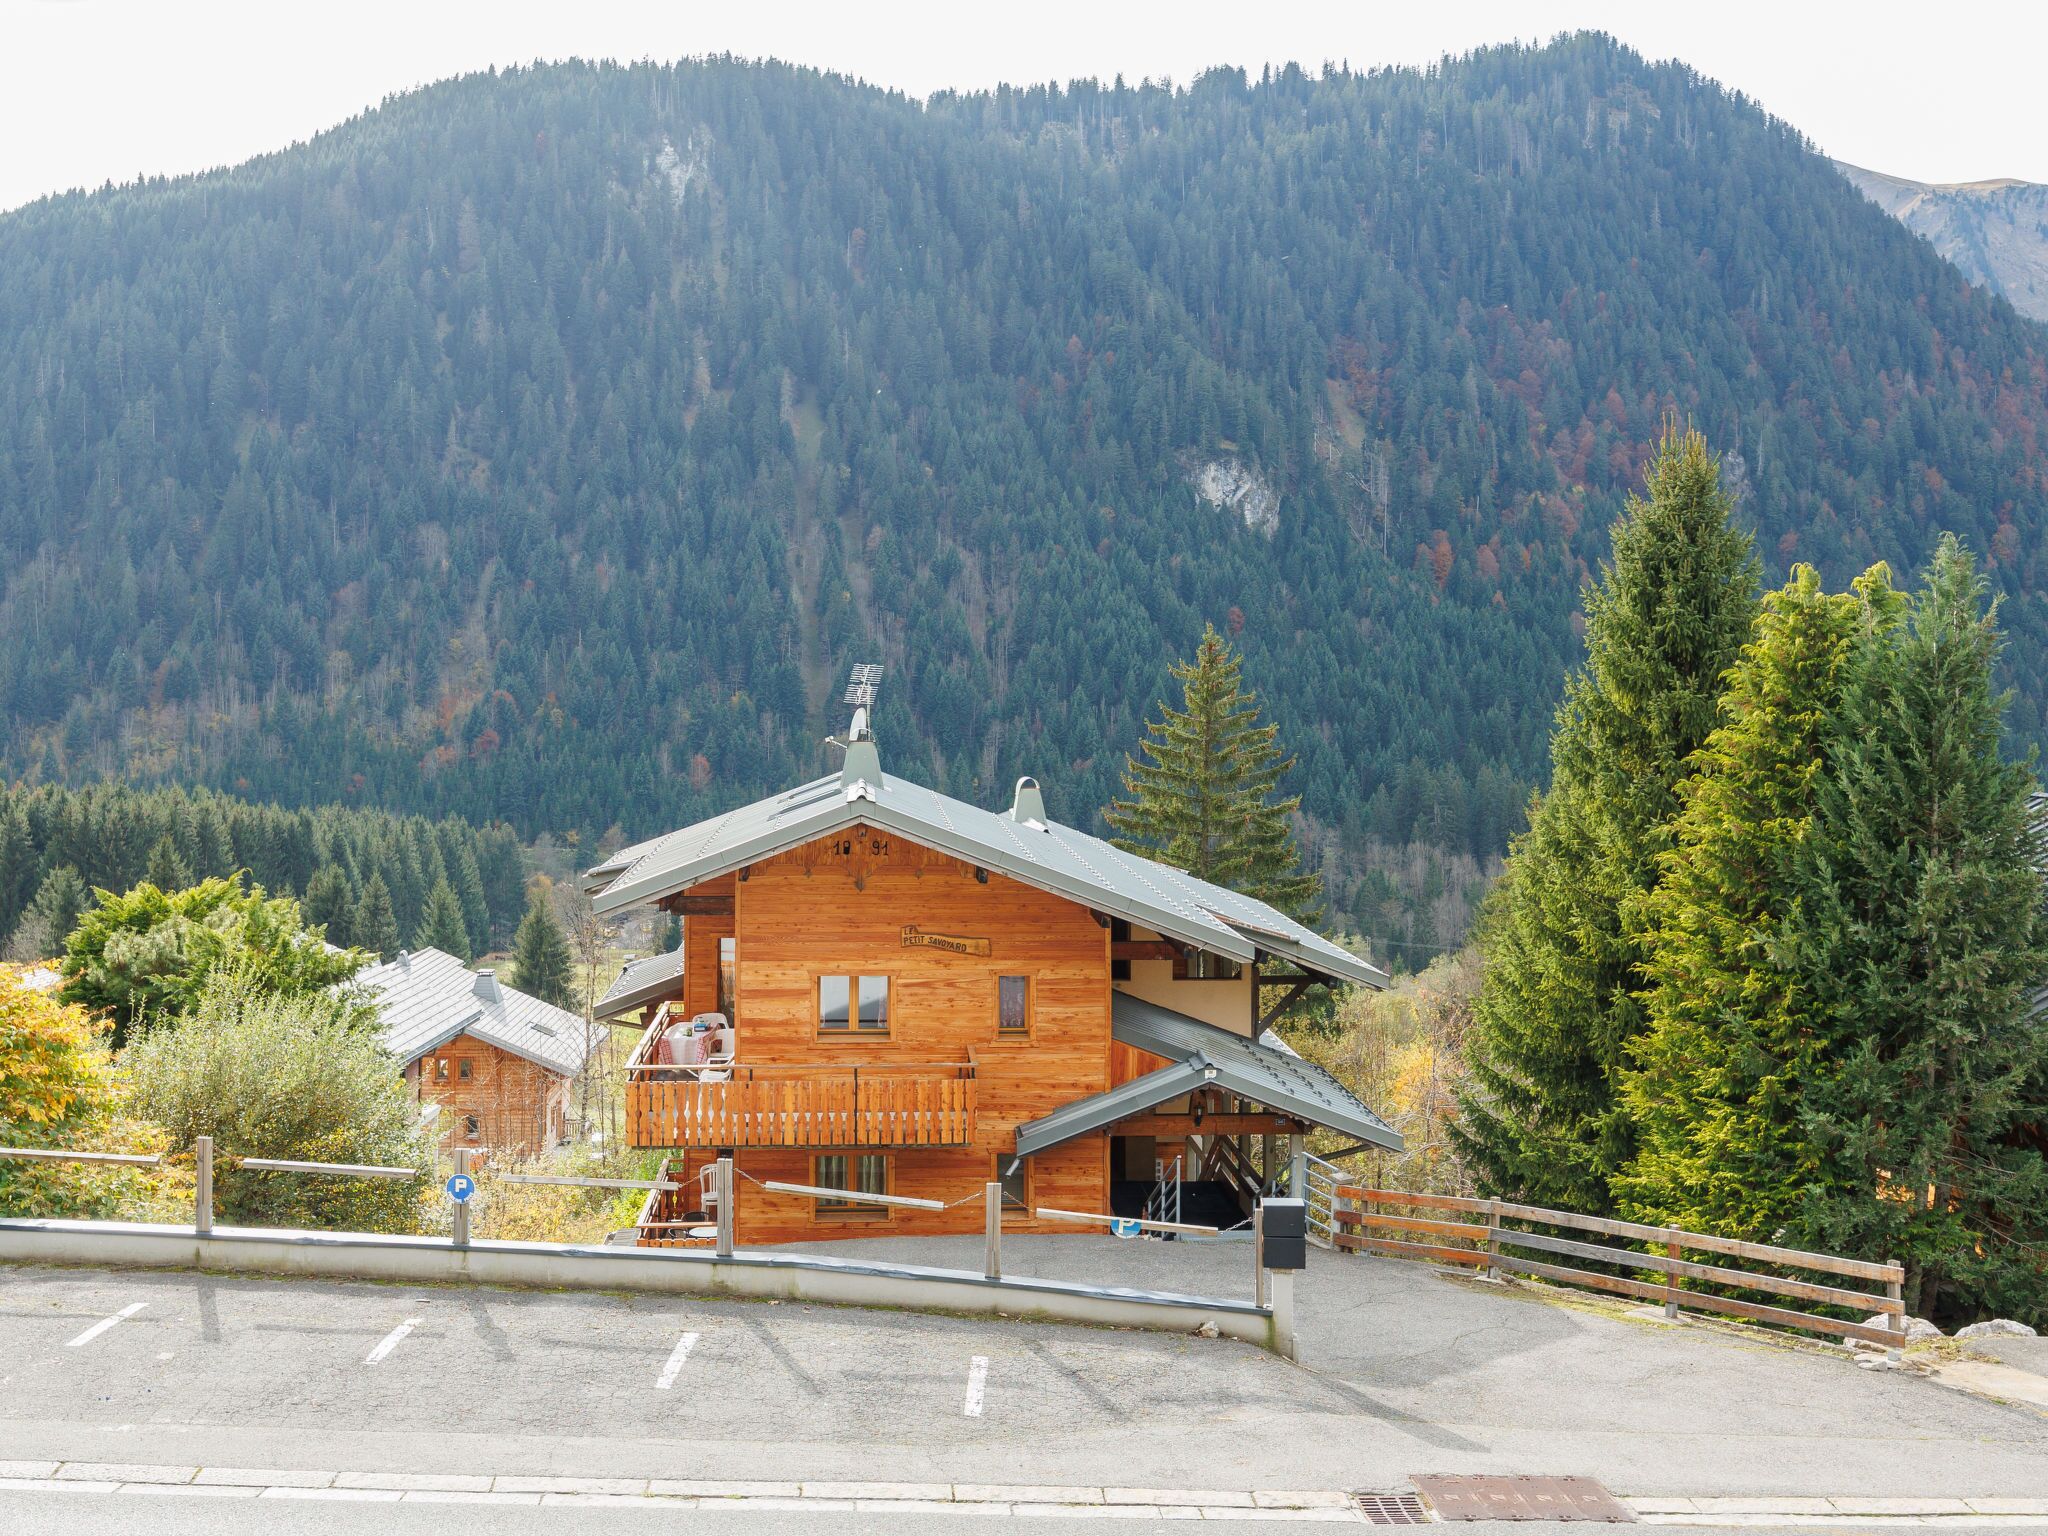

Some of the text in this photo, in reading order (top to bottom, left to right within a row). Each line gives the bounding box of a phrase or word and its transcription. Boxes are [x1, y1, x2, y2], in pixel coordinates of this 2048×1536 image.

[872, 840, 889, 856] 91
[903, 936, 967, 952] PETIT SAVOYARD
[455, 1178, 467, 1193] P
[1118, 1218, 1136, 1234] P
